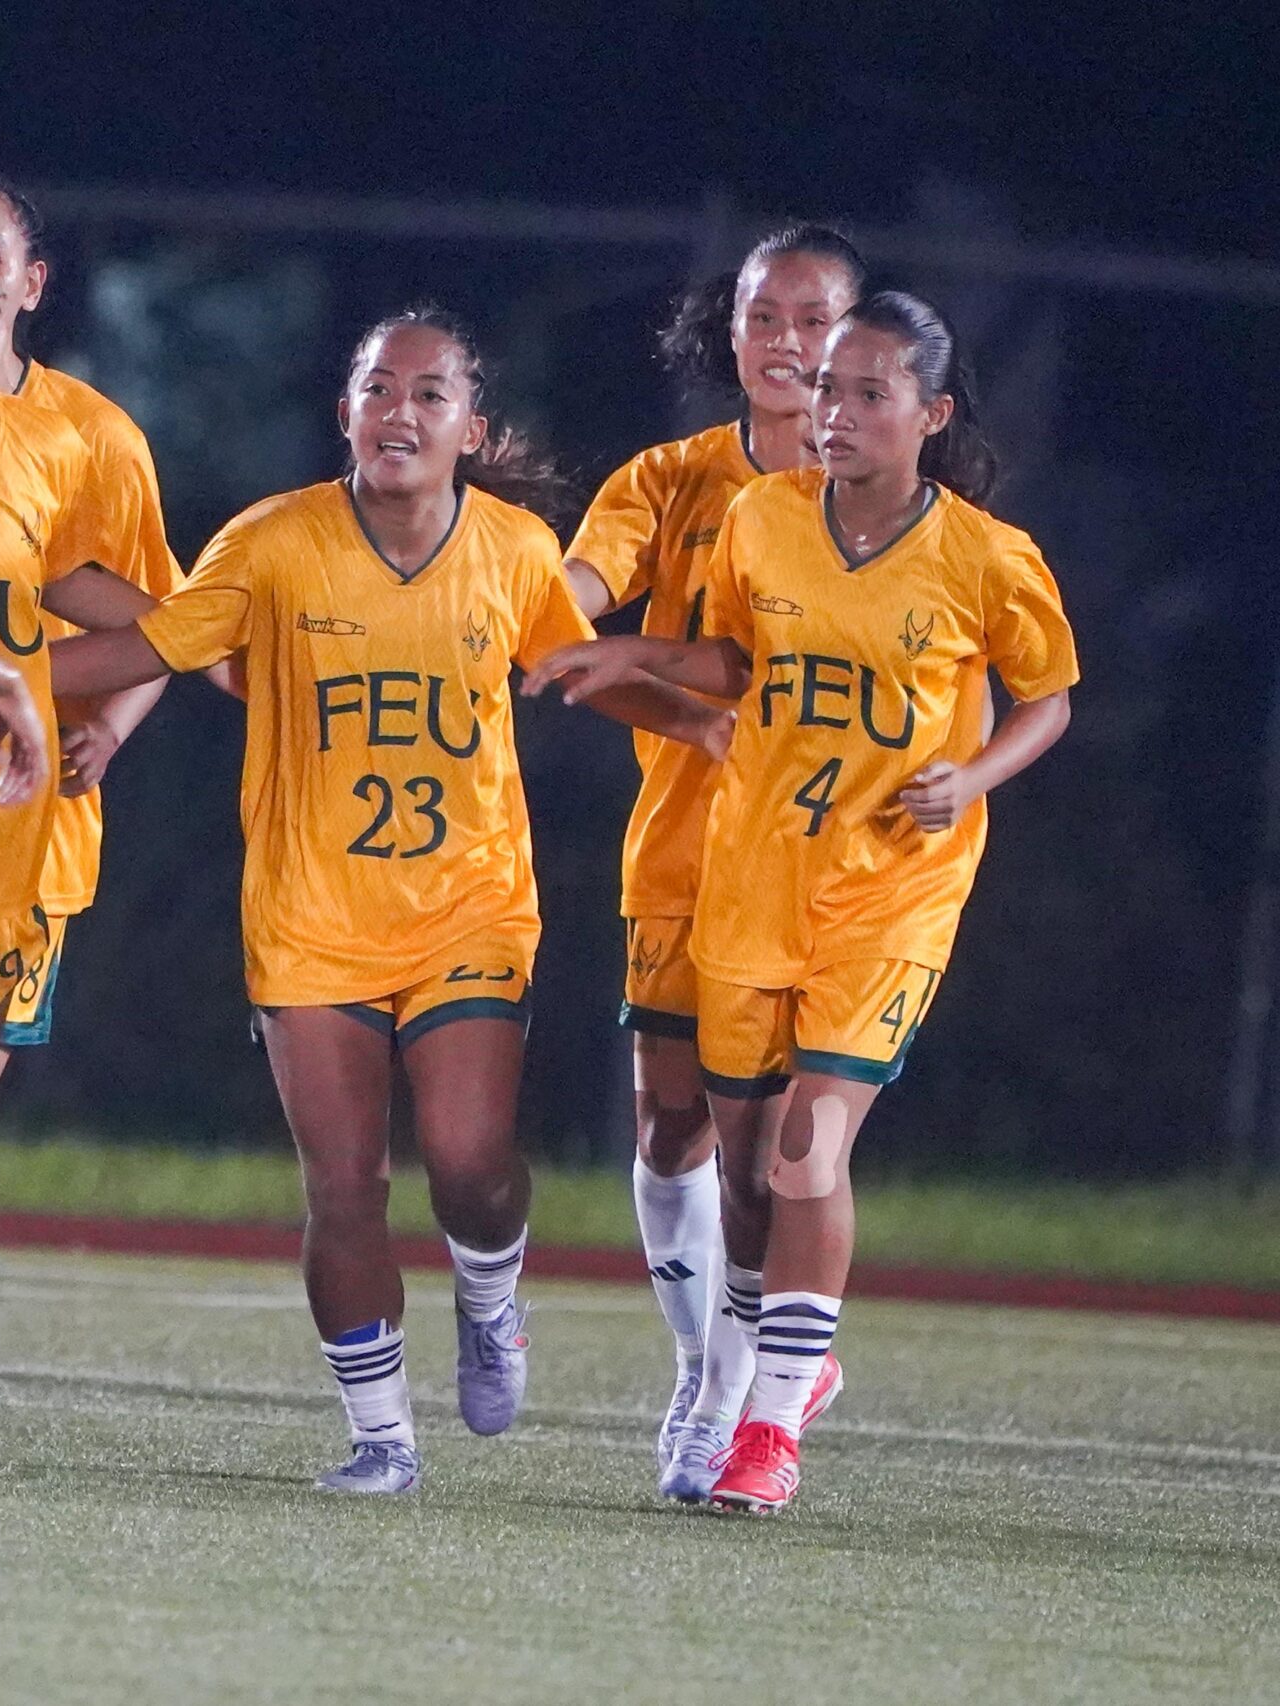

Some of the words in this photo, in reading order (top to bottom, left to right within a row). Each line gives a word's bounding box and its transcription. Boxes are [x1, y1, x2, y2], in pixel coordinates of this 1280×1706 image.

[315, 669, 482, 759] FEU
[760, 653, 916, 750] FEU
[346, 774, 448, 859] 23
[794, 757, 843, 837] 4
[880, 989, 907, 1045] 4
